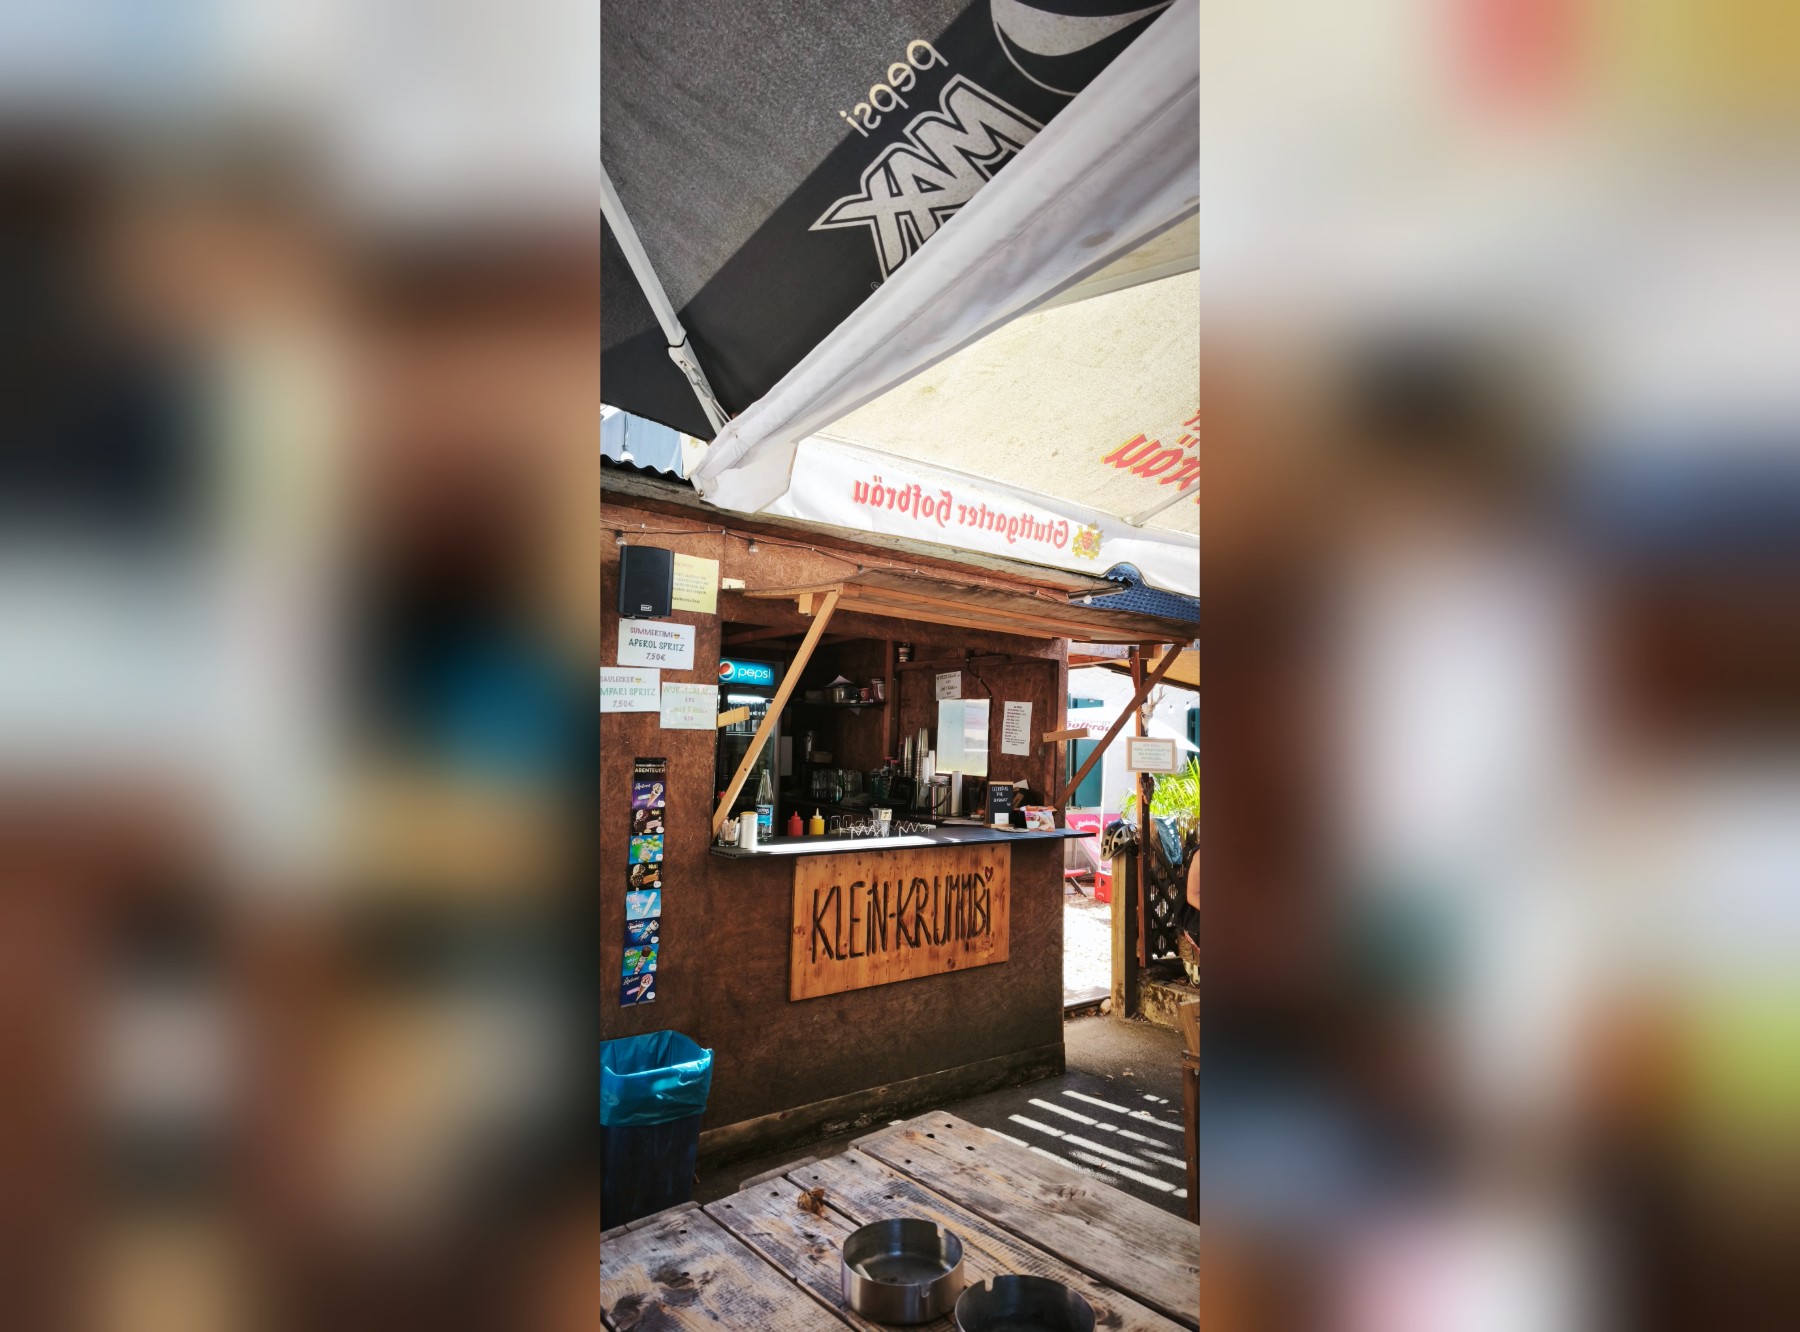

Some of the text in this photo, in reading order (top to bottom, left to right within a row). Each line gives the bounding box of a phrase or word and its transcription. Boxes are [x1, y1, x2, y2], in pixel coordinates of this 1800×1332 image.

[630, 626, 674, 639] SUMMERTIME
[628, 638, 685, 652] APEROL SPRITZ
[737, 668, 771, 680] pepsi
[629, 688, 656, 697] SPRITZ
